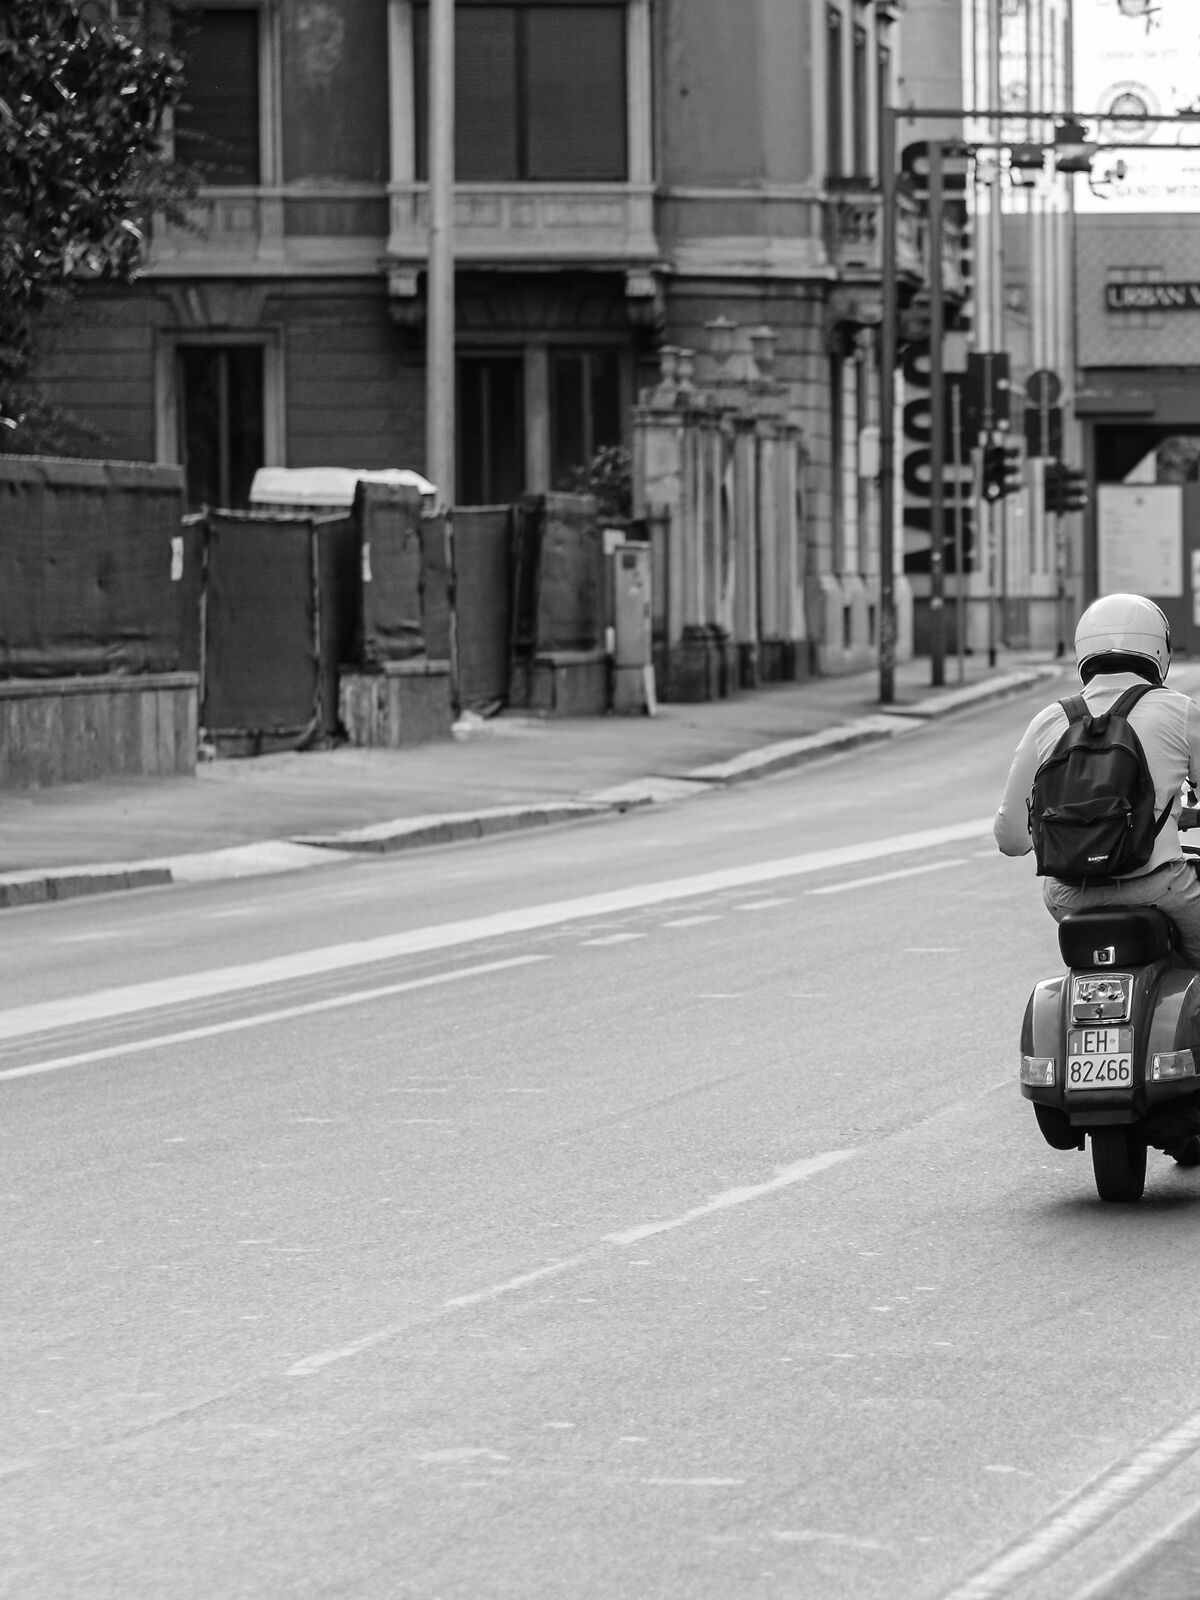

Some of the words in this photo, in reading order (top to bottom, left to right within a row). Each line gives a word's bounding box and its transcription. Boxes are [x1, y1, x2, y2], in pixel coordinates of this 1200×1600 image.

[1108, 286, 1187, 307] URBAN
[1084, 1031, 1107, 1053] EH
[1071, 1059, 1130, 1082] 82466
